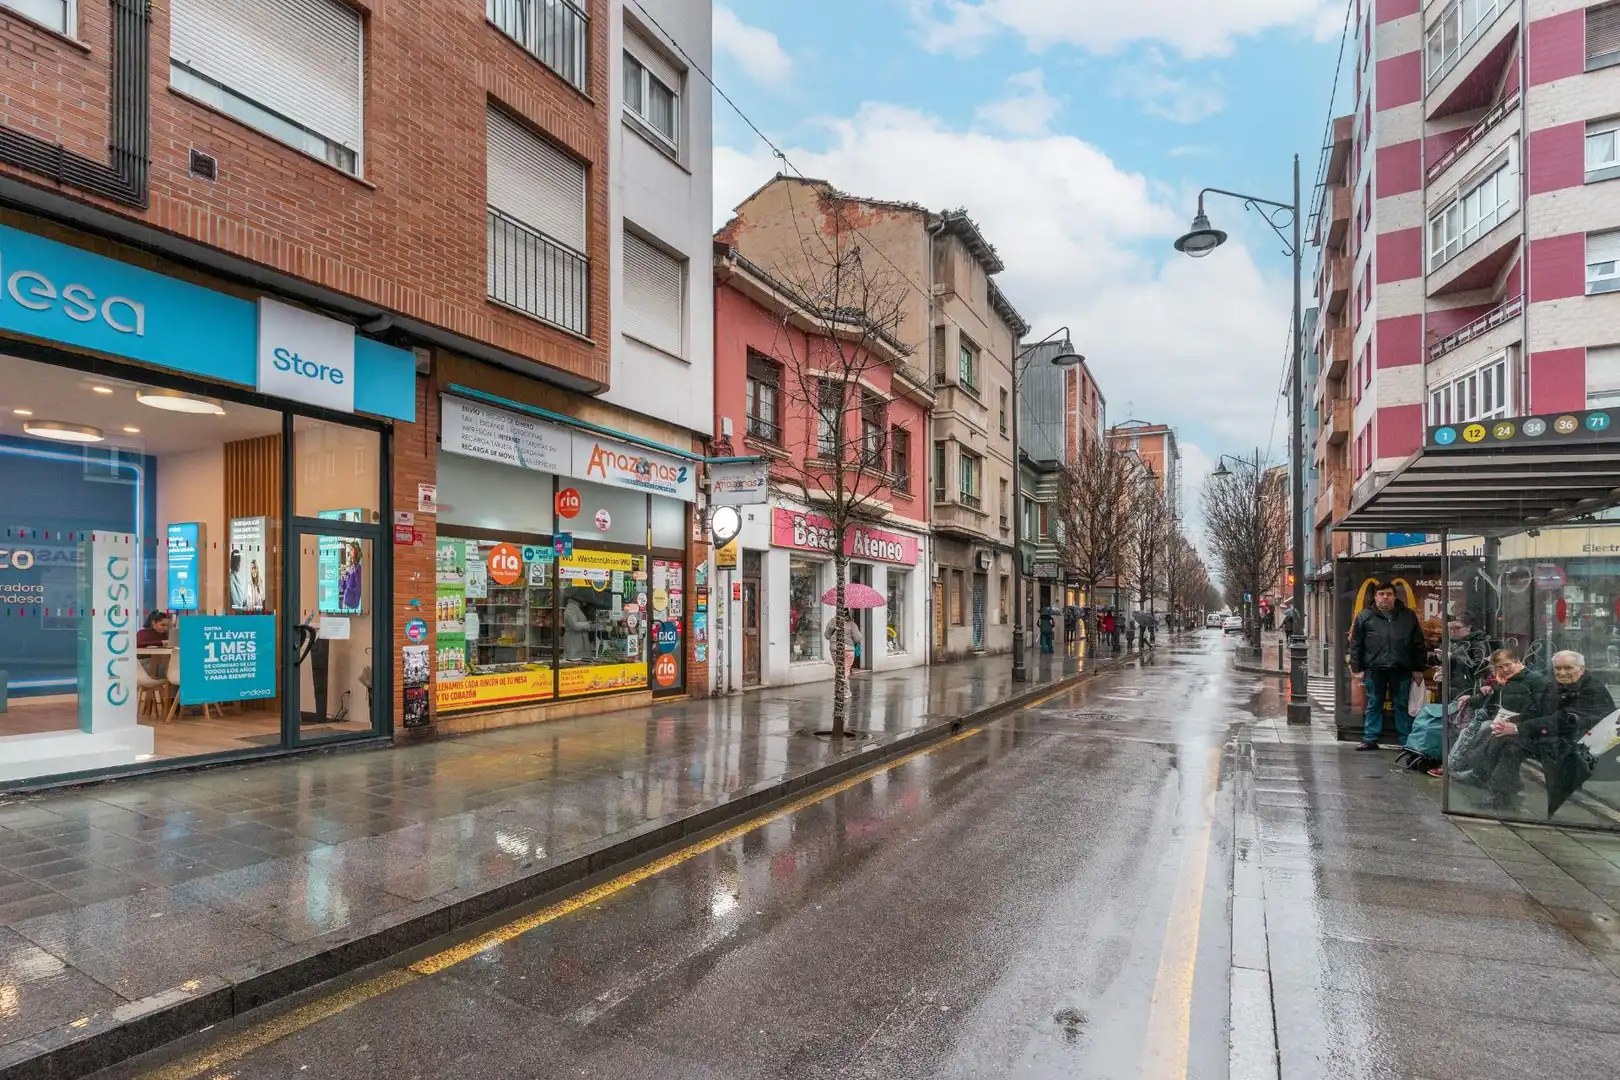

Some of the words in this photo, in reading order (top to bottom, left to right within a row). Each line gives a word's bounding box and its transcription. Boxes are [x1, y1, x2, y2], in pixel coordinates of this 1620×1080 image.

[0, 252, 144, 336] esa
[273, 347, 344, 385] Store
[1469, 429, 1481, 438] 12
[1497, 426, 1511, 436] 24
[1527, 423, 1541, 432] 34
[1559, 420, 1573, 430] 36
[1591, 417, 1604, 426] 71
[461, 442, 490, 454] RECARGA
[498, 450, 516, 461] MÓVIL
[676, 466, 688, 484] 2
[560, 492, 579, 507] ria
[794, 514, 846, 551] Baza
[853, 529, 903, 561] Ateneo
[492, 548, 519, 570] ria
[102, 556, 130, 706] endesa
[204, 632, 212, 640] Y
[214, 630, 256, 640] LLÉVATE
[658, 632, 676, 640] DIGI
[204, 642, 219, 662] 1
[220, 640, 256, 654] MES
[220, 653, 256, 662] GRATIS
[658, 658, 675, 674] ria
[464, 680, 479, 688] CADA
[480, 678, 498, 688] RINCÓN
[240, 688, 271, 697] endesa
[436, 694, 440, 702] Y
[450, 690, 476, 700] CORAZÓN
